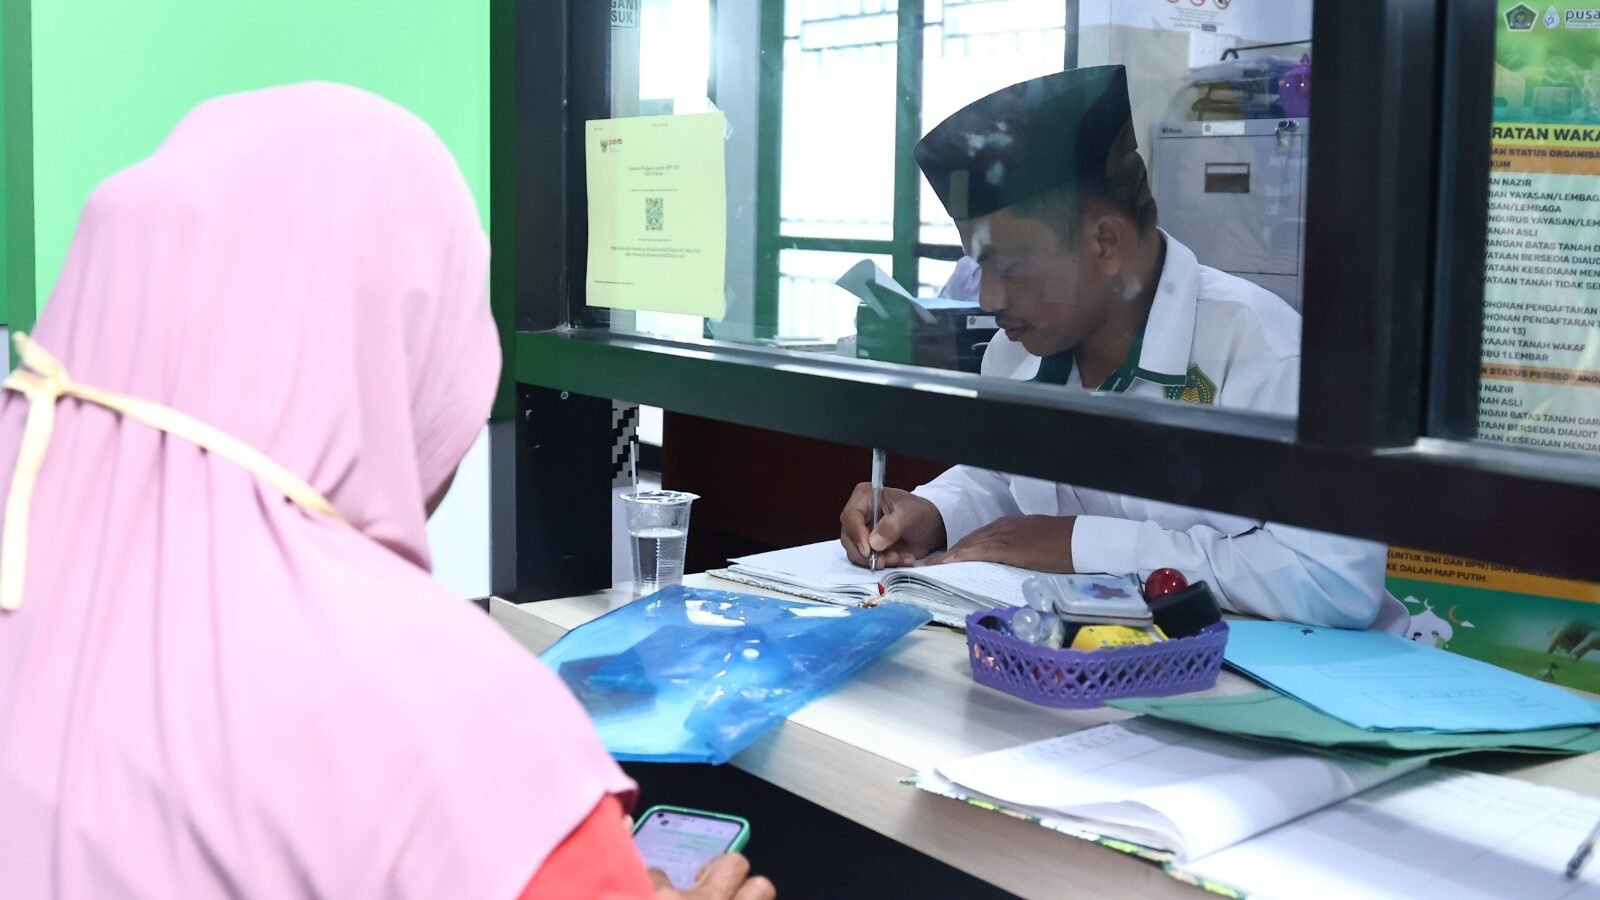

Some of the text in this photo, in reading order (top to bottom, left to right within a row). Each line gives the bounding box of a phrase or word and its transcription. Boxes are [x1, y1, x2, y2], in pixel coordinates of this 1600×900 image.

[611, 10, 633, 24] SUK
[1491, 127, 1549, 141] RATAN
[1509, 149, 1547, 158] STATUS
[1502, 179, 1532, 187] NAZIR
[1510, 191, 1600, 202] YAYASAN/LEMBAG
[1487, 203, 1561, 213] SAN/LEMBAGA
[1516, 229, 1539, 237] ASLI
[1525, 241, 1557, 250] BATAS
[1558, 243, 1592, 252] TANAH
[1521, 254, 1570, 264] BERSEDIA
[1521, 265, 1577, 276] KESEDIAAN
[1520, 278, 1552, 288] TANAH
[1555, 281, 1584, 290] TIDAK
[1525, 303, 1598, 315] PENDAFTARAN
[1523, 315, 1595, 328] PENDAFTARAN
[1512, 327, 1527, 337] 13)
[1517, 339, 1550, 350] TANAH
[1552, 342, 1586, 352] WAKAF
[1508, 351, 1549, 361] LEMBAR
[1489, 367, 1527, 378] STATUS
[1484, 383, 1514, 393] NAZIR
[1501, 398, 1523, 407] ASLI
[1510, 411, 1541, 421] BATAS
[1543, 414, 1576, 424] TANAH
[1507, 423, 1556, 435] BERSEDIA
[1558, 427, 1599, 439] DIAUDIT
[1506, 435, 1561, 448] KESEDIAAN
[1443, 557, 1463, 567] DAN
[1400, 564, 1433, 576] DALAM
[1434, 567, 1456, 577] MAP
